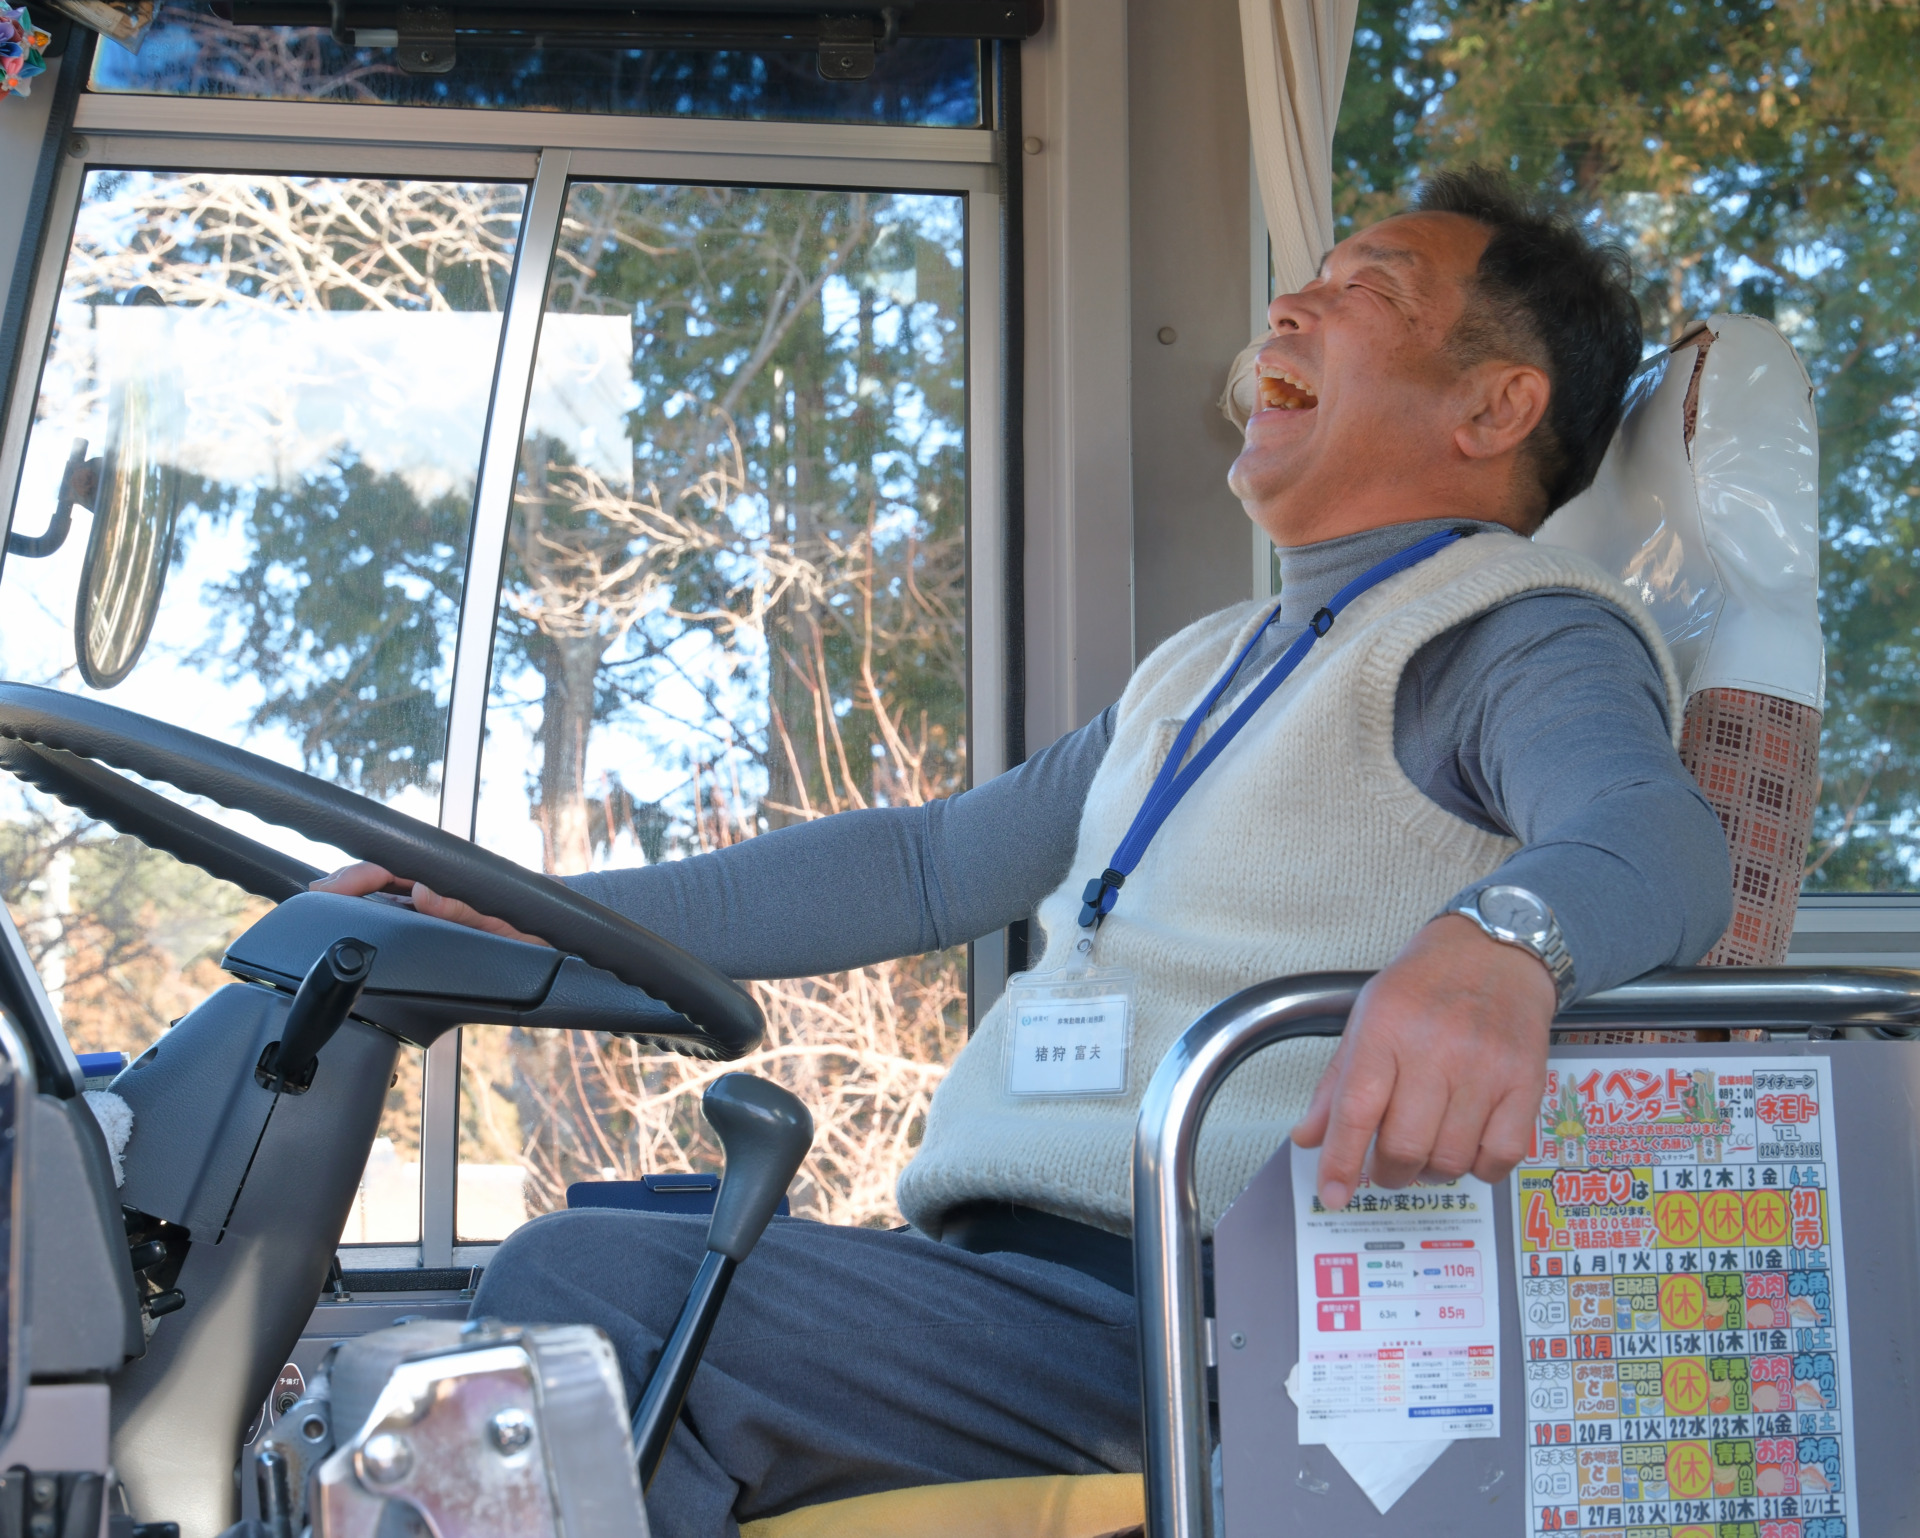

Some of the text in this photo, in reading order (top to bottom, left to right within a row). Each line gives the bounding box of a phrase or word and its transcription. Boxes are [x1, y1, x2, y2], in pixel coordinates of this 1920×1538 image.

[1074, 1044, 1101, 1061] 富夫
[1577, 1068, 1689, 1103] イベント
[1586, 1099, 1681, 1125] カレンダー
[1757, 1094, 1818, 1123] ネモト
[1587, 1137, 1693, 1151] 今年もよろしくお願い
[1726, 1134, 1754, 1146] CGC
[1772, 1124, 1801, 1141] TEL
[1589, 1152, 1659, 1165] 申し上げます。
[1760, 1143, 1820, 1158] 0240-25-3165
[1660, 1199, 1693, 1236] 休
[1708, 1198, 1740, 1234] 休
[1750, 1198, 1781, 1234] 休
[1791, 1189, 1822, 1248] 初売
[1443, 1264, 1475, 1277] 110円
[1746, 1273, 1786, 1298] お肉
[1788, 1272, 1829, 1297] お魚
[1439, 1307, 1465, 1319] 85円
[1665, 1284, 1698, 1320] 休
[1751, 1355, 1791, 1381] お肉
[1794, 1352, 1835, 1379] お魚
[279, 1377, 300, 1386] 予備灯
[1669, 1367, 1701, 1404] 休
[1756, 1438, 1796, 1464] お肉
[1799, 1437, 1839, 1463] お魚
[1673, 1452, 1705, 1488] 休
